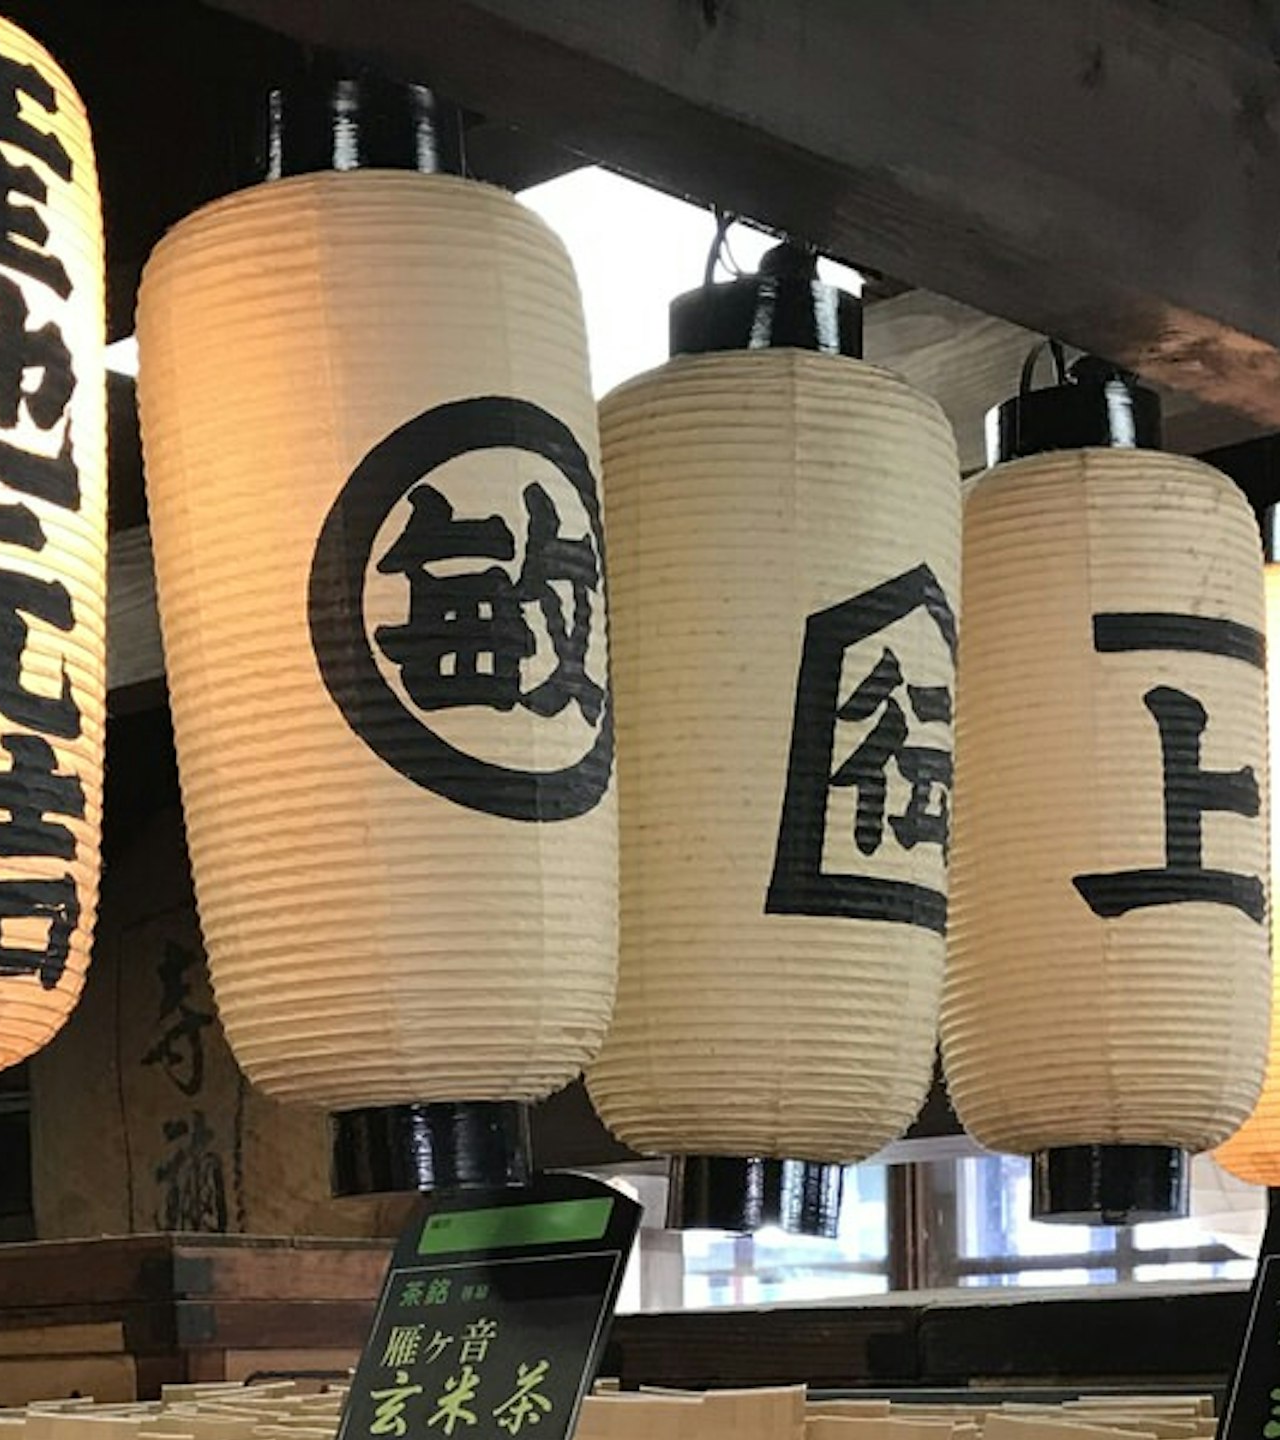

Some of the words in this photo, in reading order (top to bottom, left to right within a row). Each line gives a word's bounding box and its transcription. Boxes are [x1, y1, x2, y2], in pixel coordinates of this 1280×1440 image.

[400, 1280, 451, 1306] 茶銘
[369, 1360, 552, 1436] 玄米茶
